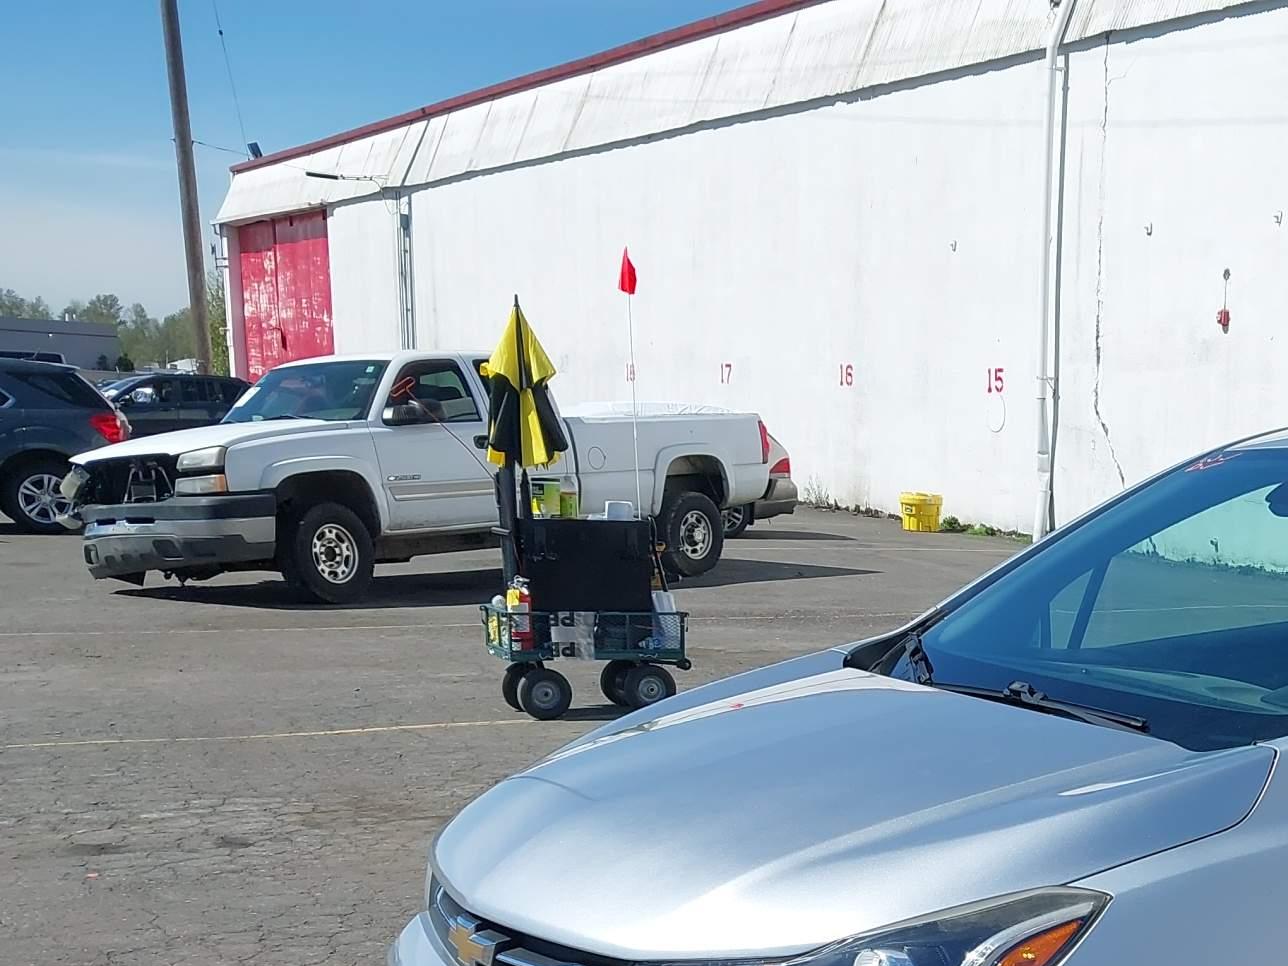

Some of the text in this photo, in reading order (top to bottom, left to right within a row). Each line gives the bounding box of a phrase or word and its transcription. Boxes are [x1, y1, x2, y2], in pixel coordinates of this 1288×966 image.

[720, 363, 733, 384] 17
[839, 364, 854, 387] 16
[987, 367, 1004, 393] 15
